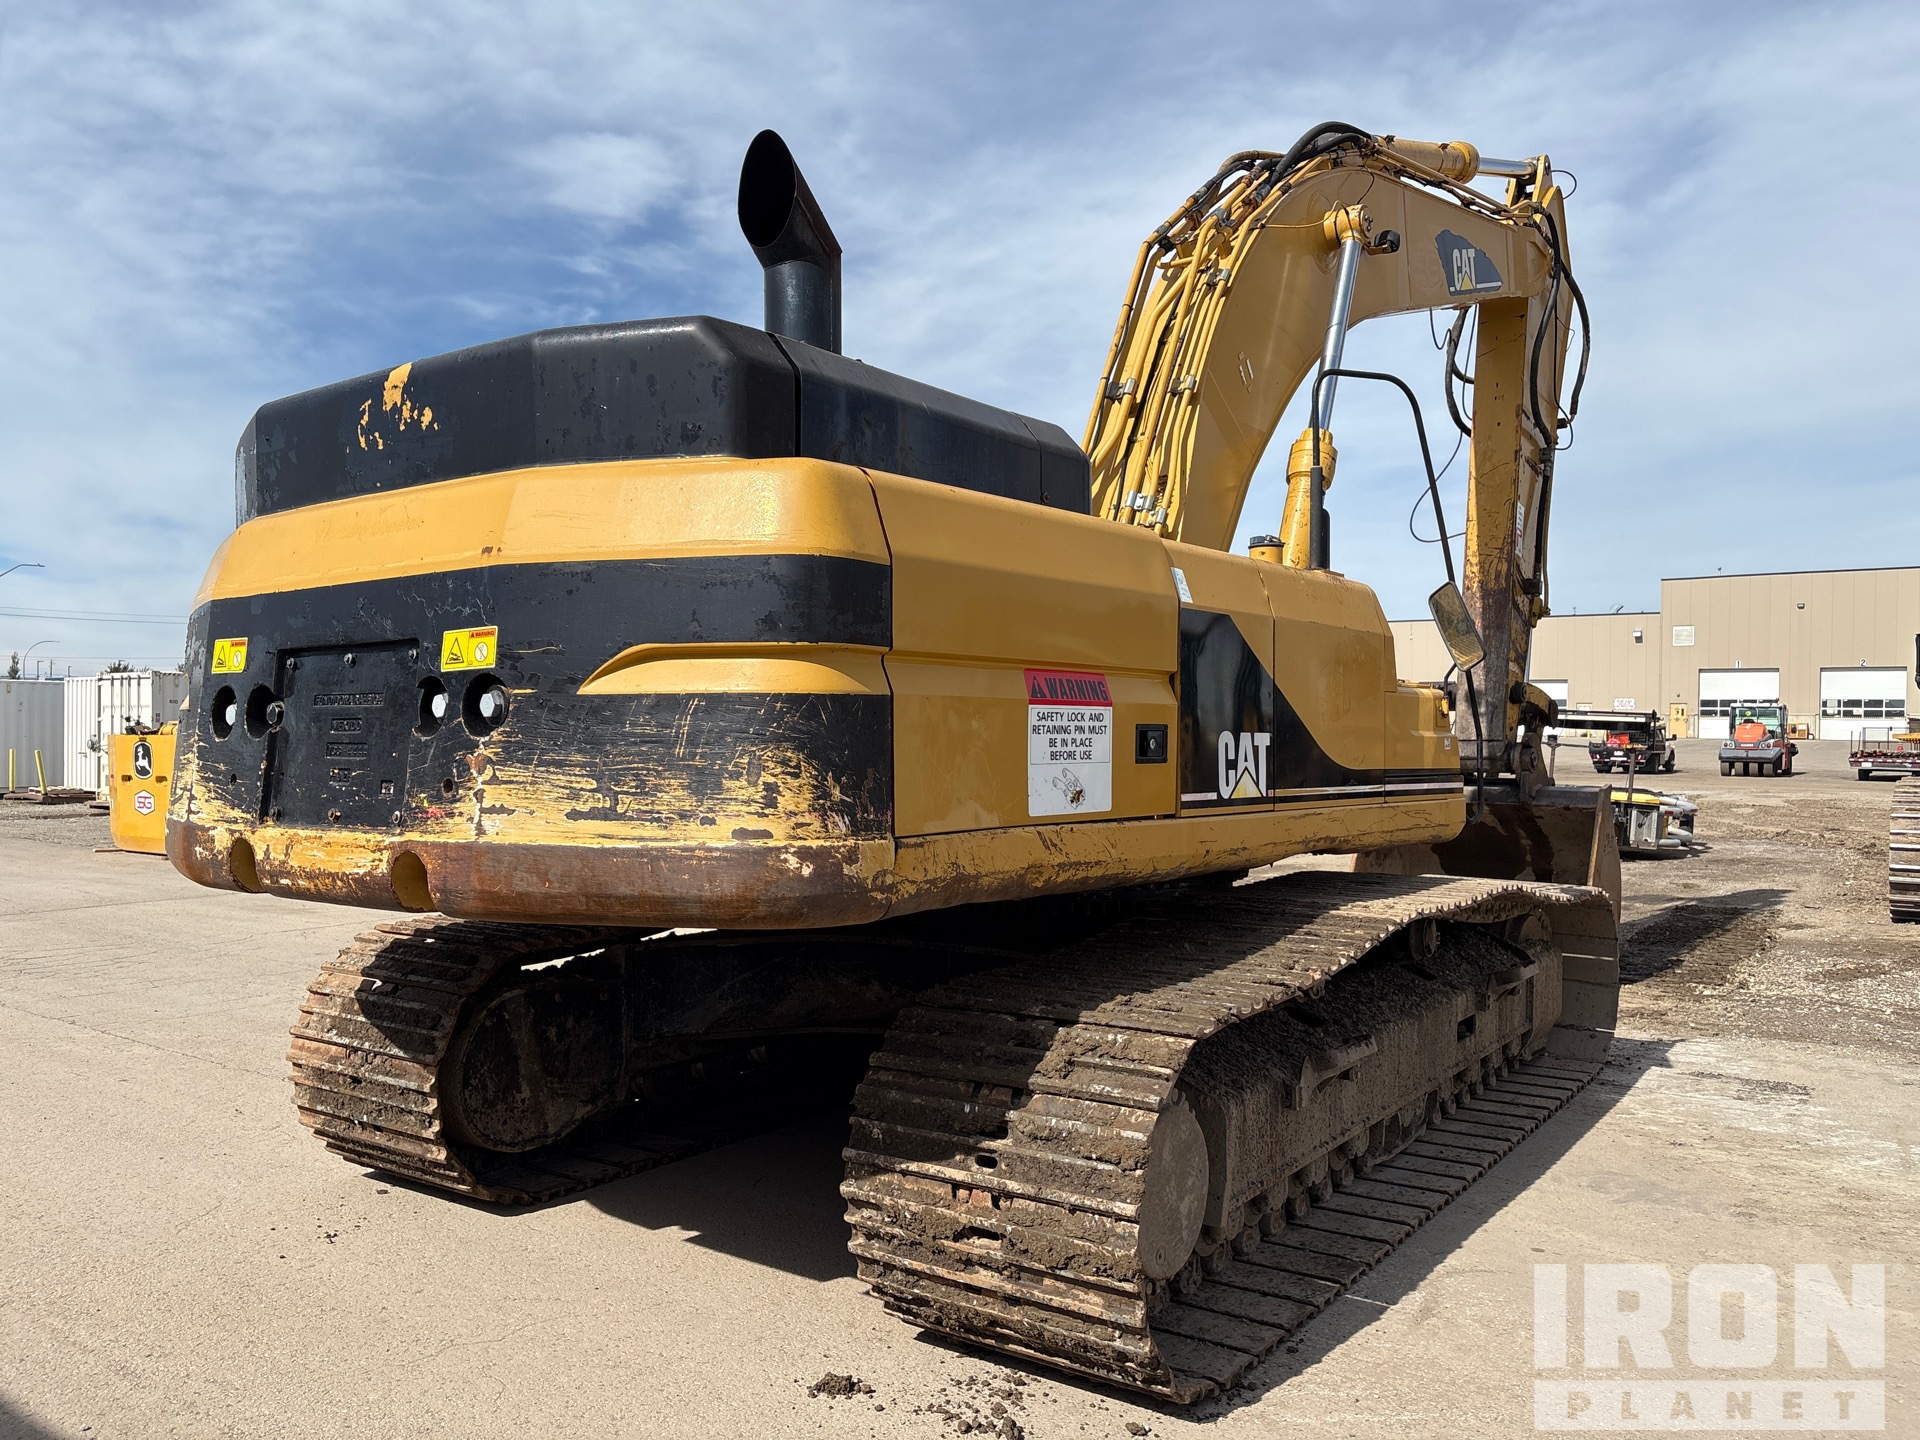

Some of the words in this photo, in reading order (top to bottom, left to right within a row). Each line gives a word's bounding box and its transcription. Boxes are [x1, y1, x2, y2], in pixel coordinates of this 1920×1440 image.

[1452, 249, 1475, 290] CAT
[1860, 659, 1866, 667] 2
[1044, 677, 1109, 701] WARNING
[1036, 711, 1065, 722] SAFETY
[1067, 712, 1086, 722] LOCK
[1088, 712, 1105, 722] AND
[1032, 724, 1072, 735] RETAINING
[1074, 725, 1086, 735] PIN
[1088, 725, 1108, 735] MUST
[1049, 737, 1058, 748] BE
[1060, 738, 1069, 748] IN
[1071, 737, 1093, 748] PLACE
[1050, 750, 1077, 761] BEFORE
[1079, 750, 1093, 760] USE
[1218, 730, 1271, 799] CAT
